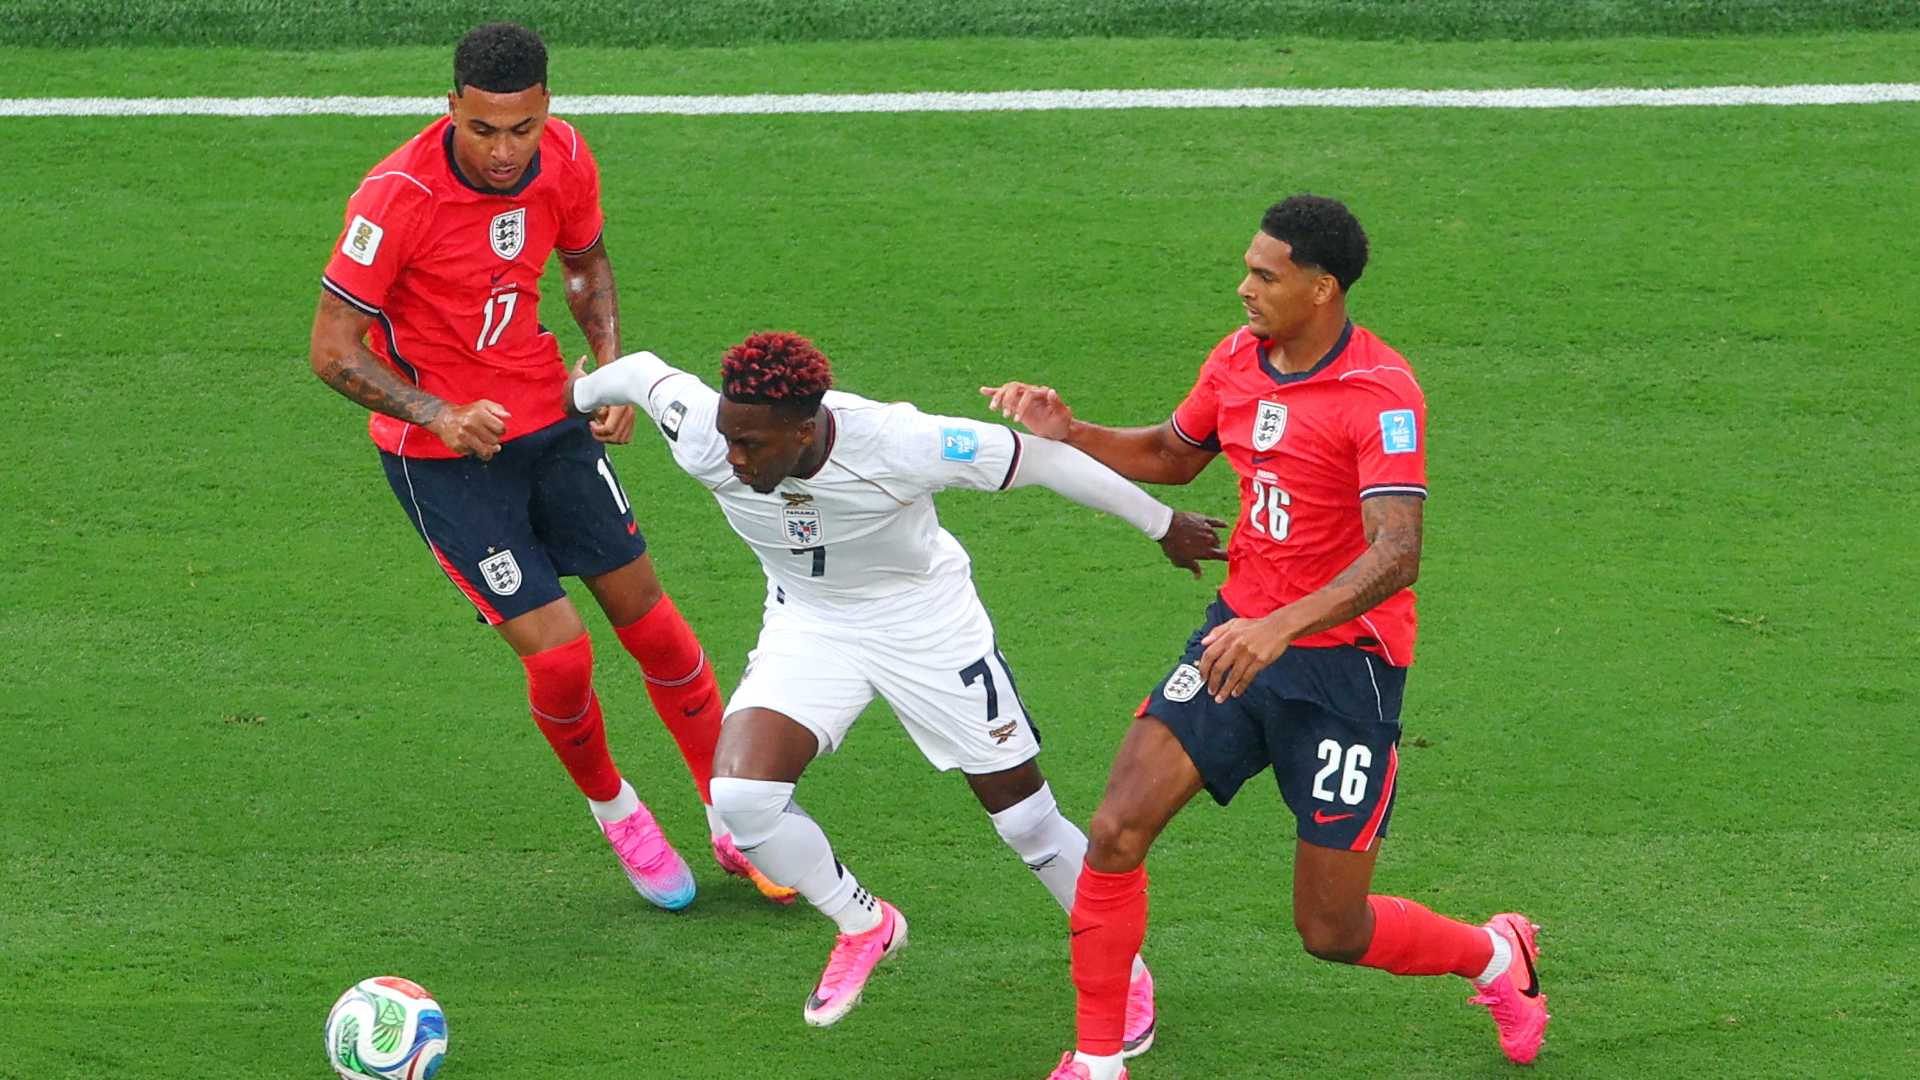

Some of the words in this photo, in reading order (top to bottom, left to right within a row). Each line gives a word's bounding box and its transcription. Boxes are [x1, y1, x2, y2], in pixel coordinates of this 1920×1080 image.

[476, 292, 519, 352] 17
[1250, 480, 1291, 542] 26
[790, 545, 826, 577] 7
[958, 656, 999, 722] 7
[1311, 739, 1372, 805] 26
